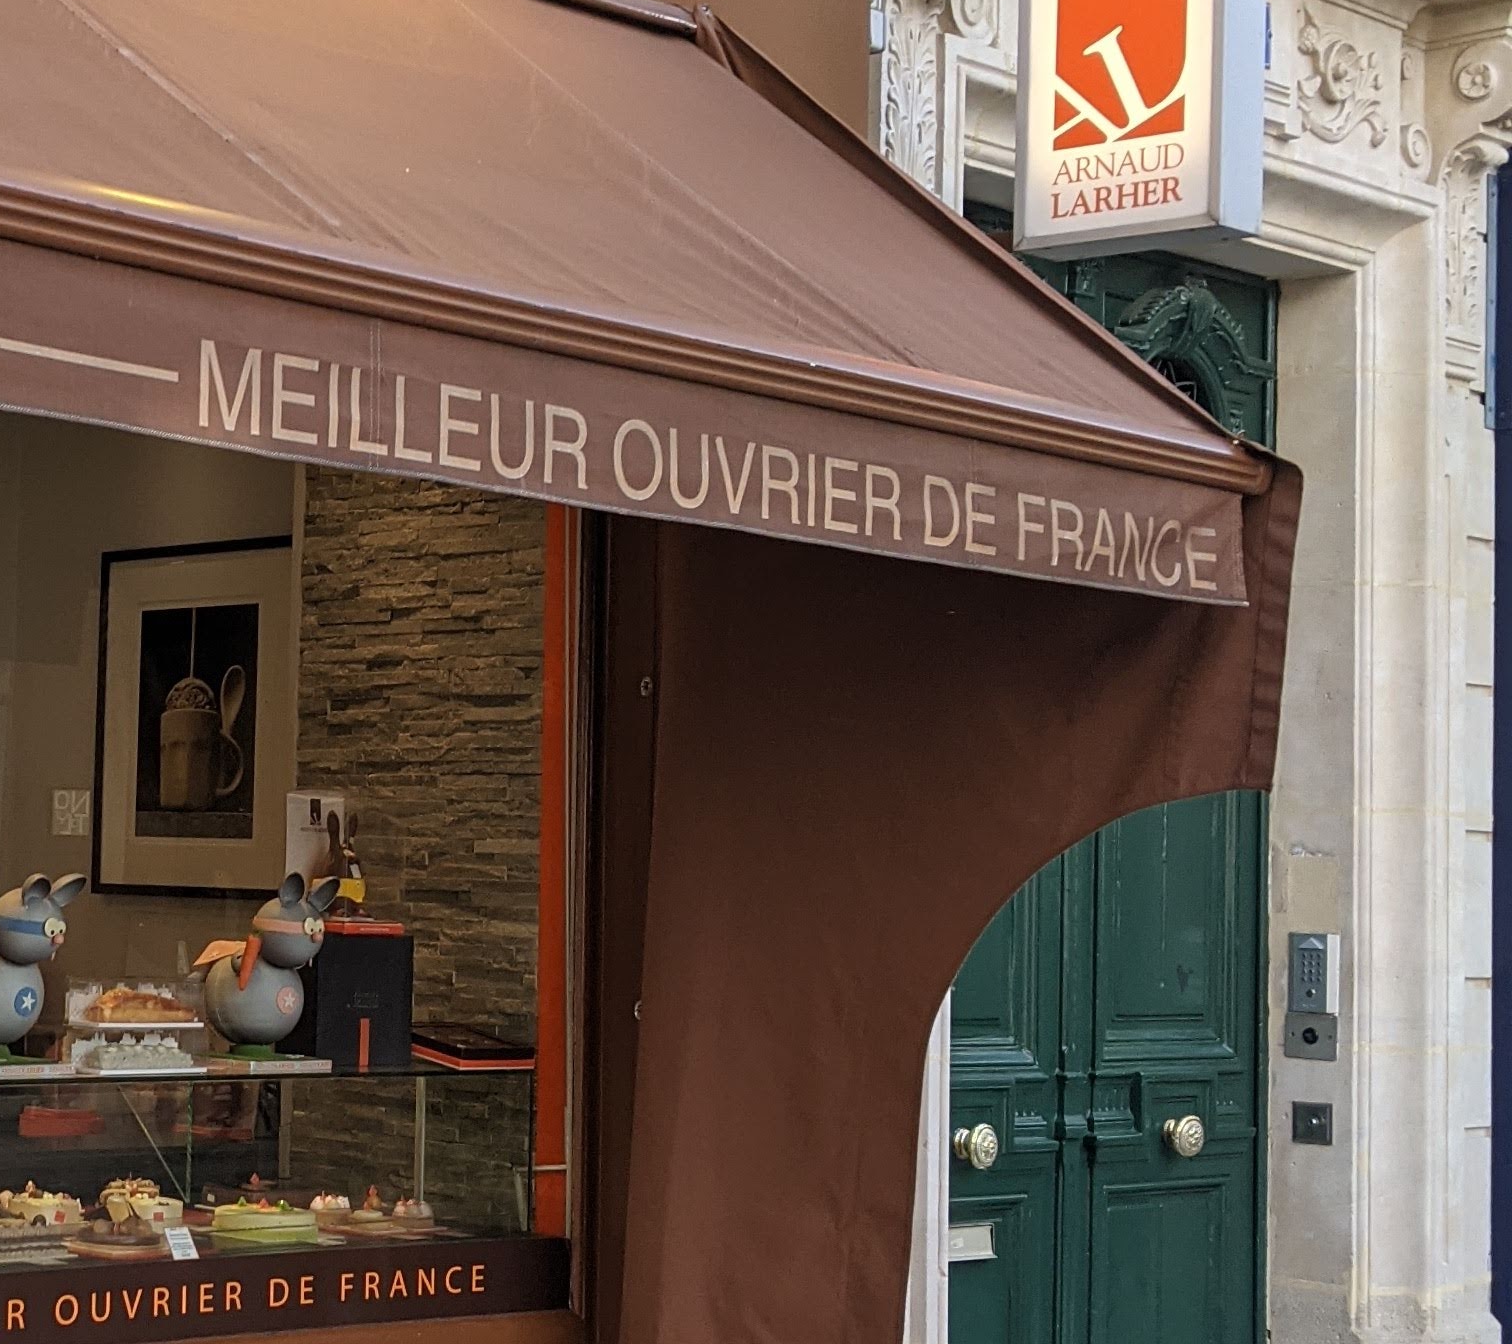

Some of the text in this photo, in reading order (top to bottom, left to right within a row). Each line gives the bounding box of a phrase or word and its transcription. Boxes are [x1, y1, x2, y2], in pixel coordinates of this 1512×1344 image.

[1052, 143, 1185, 186] ARNAUD
[1050, 176, 1183, 219] LARHER
[198, 338, 1218, 591] MEILLEUR OUVRIER DE FRANCE
[54, 1281, 242, 1326] OUVRIER
[268, 1276, 315, 1308] DE
[340, 1264, 486, 1302] FRANCE
